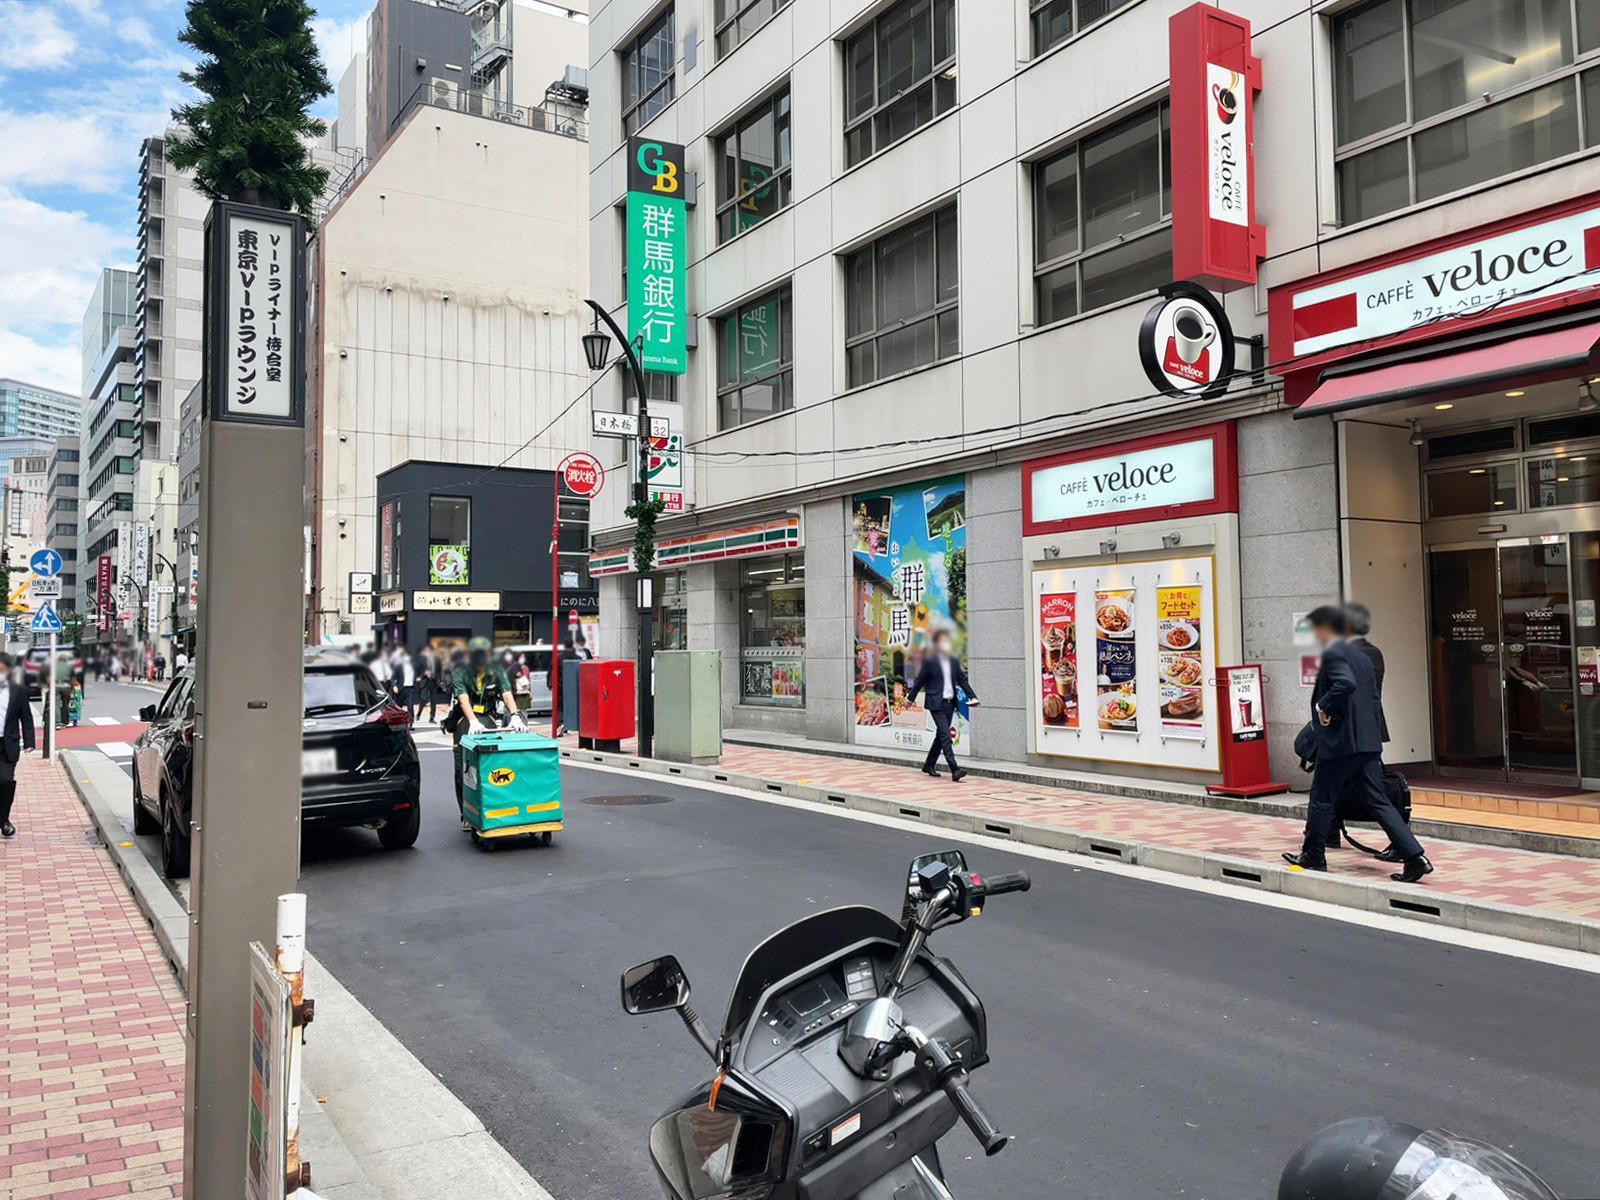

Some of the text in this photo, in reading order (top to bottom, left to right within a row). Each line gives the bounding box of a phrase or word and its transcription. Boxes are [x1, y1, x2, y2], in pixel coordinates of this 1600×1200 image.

[1221, 131, 1237, 212] veloce
[642, 204, 675, 343] 群馬銀行
[1366, 239, 1573, 309] CAFFÈ veloce
[1180, 364, 1204, 379] veloce
[600, 416, 632, 431] 日本橋
[653, 426, 667, 437] 32
[568, 468, 596, 484] 消火栓
[1060, 462, 1177, 496] CAFFÈ veloce
[663, 492, 679, 502] 銀行
[1087, 492, 1147, 509] カフェ・ベローチェ
[560, 597, 600, 607] にのに八
[889, 562, 925, 649] 群馬
[1041, 598, 1074, 614] MARRON
[1161, 600, 1197, 610] フードセット
[1452, 611, 1478, 619] veloce
